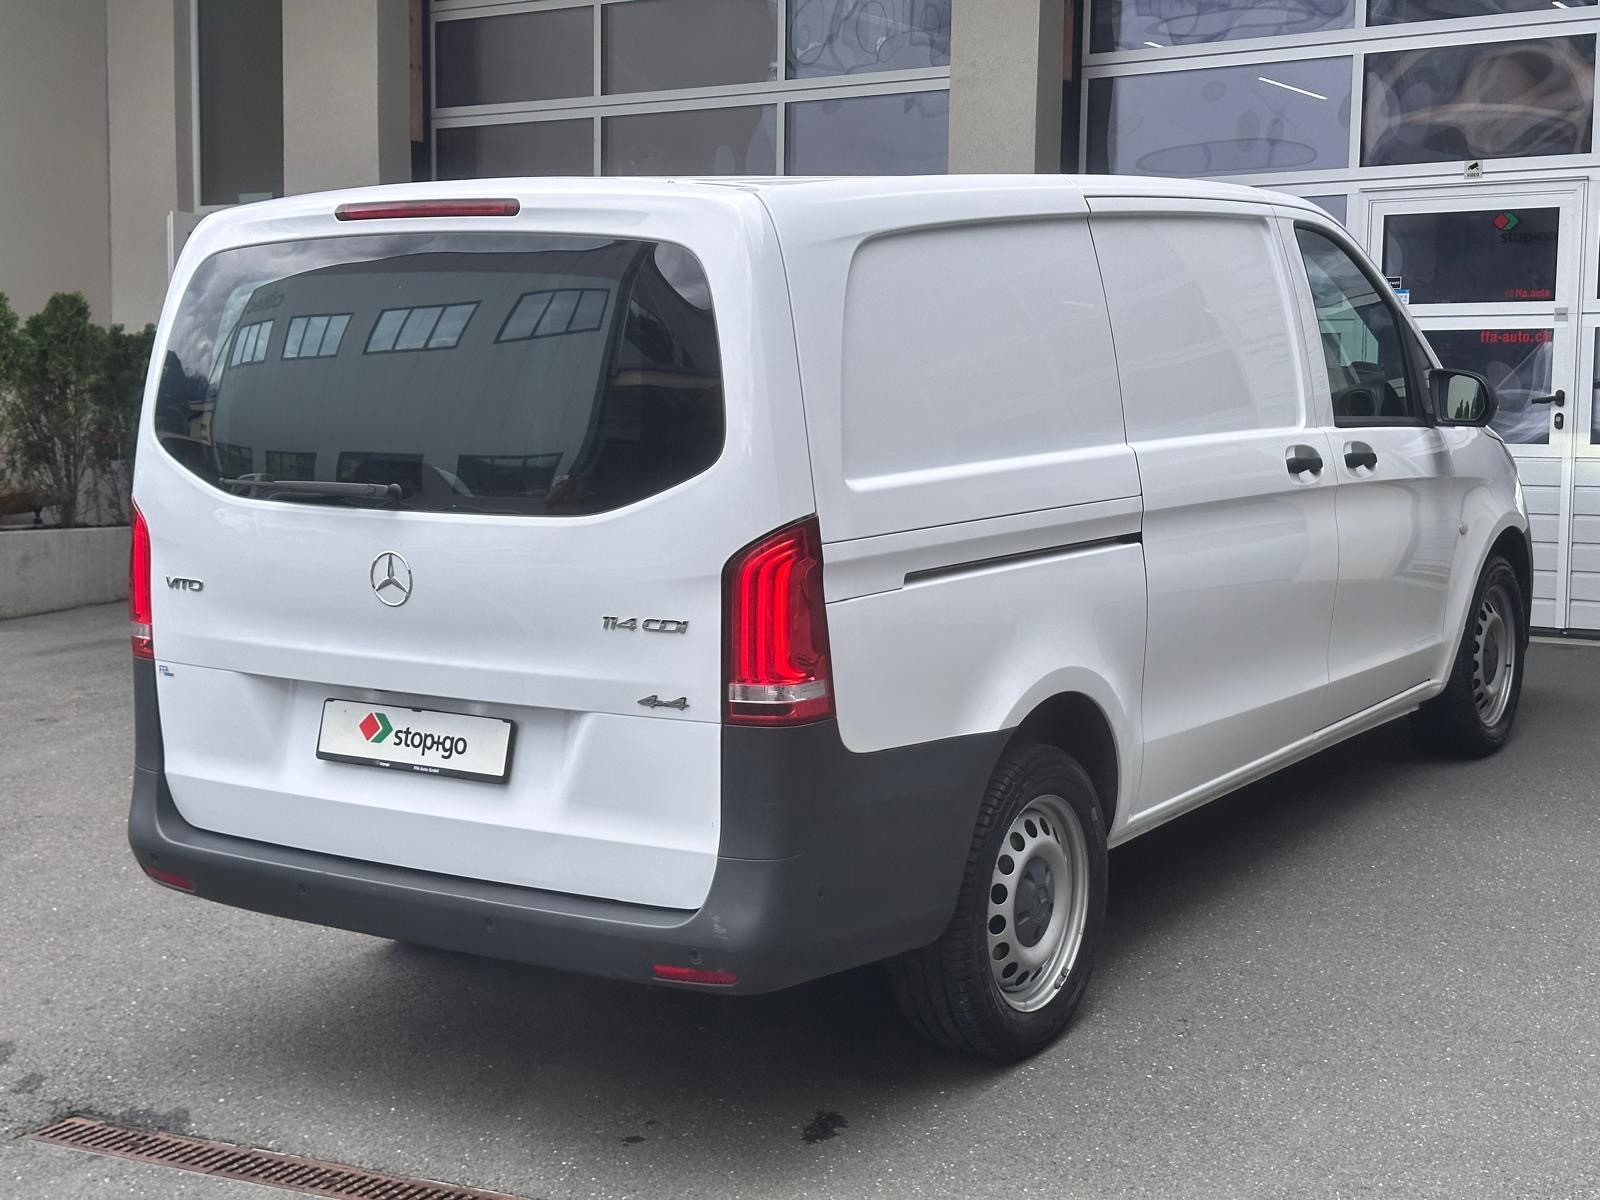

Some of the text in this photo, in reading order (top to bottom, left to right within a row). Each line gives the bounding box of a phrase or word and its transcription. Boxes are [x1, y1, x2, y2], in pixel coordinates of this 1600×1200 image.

[166, 576, 204, 592] VITO
[602, 616, 689, 634] 114 CDI
[393, 727, 468, 759] stop+go
